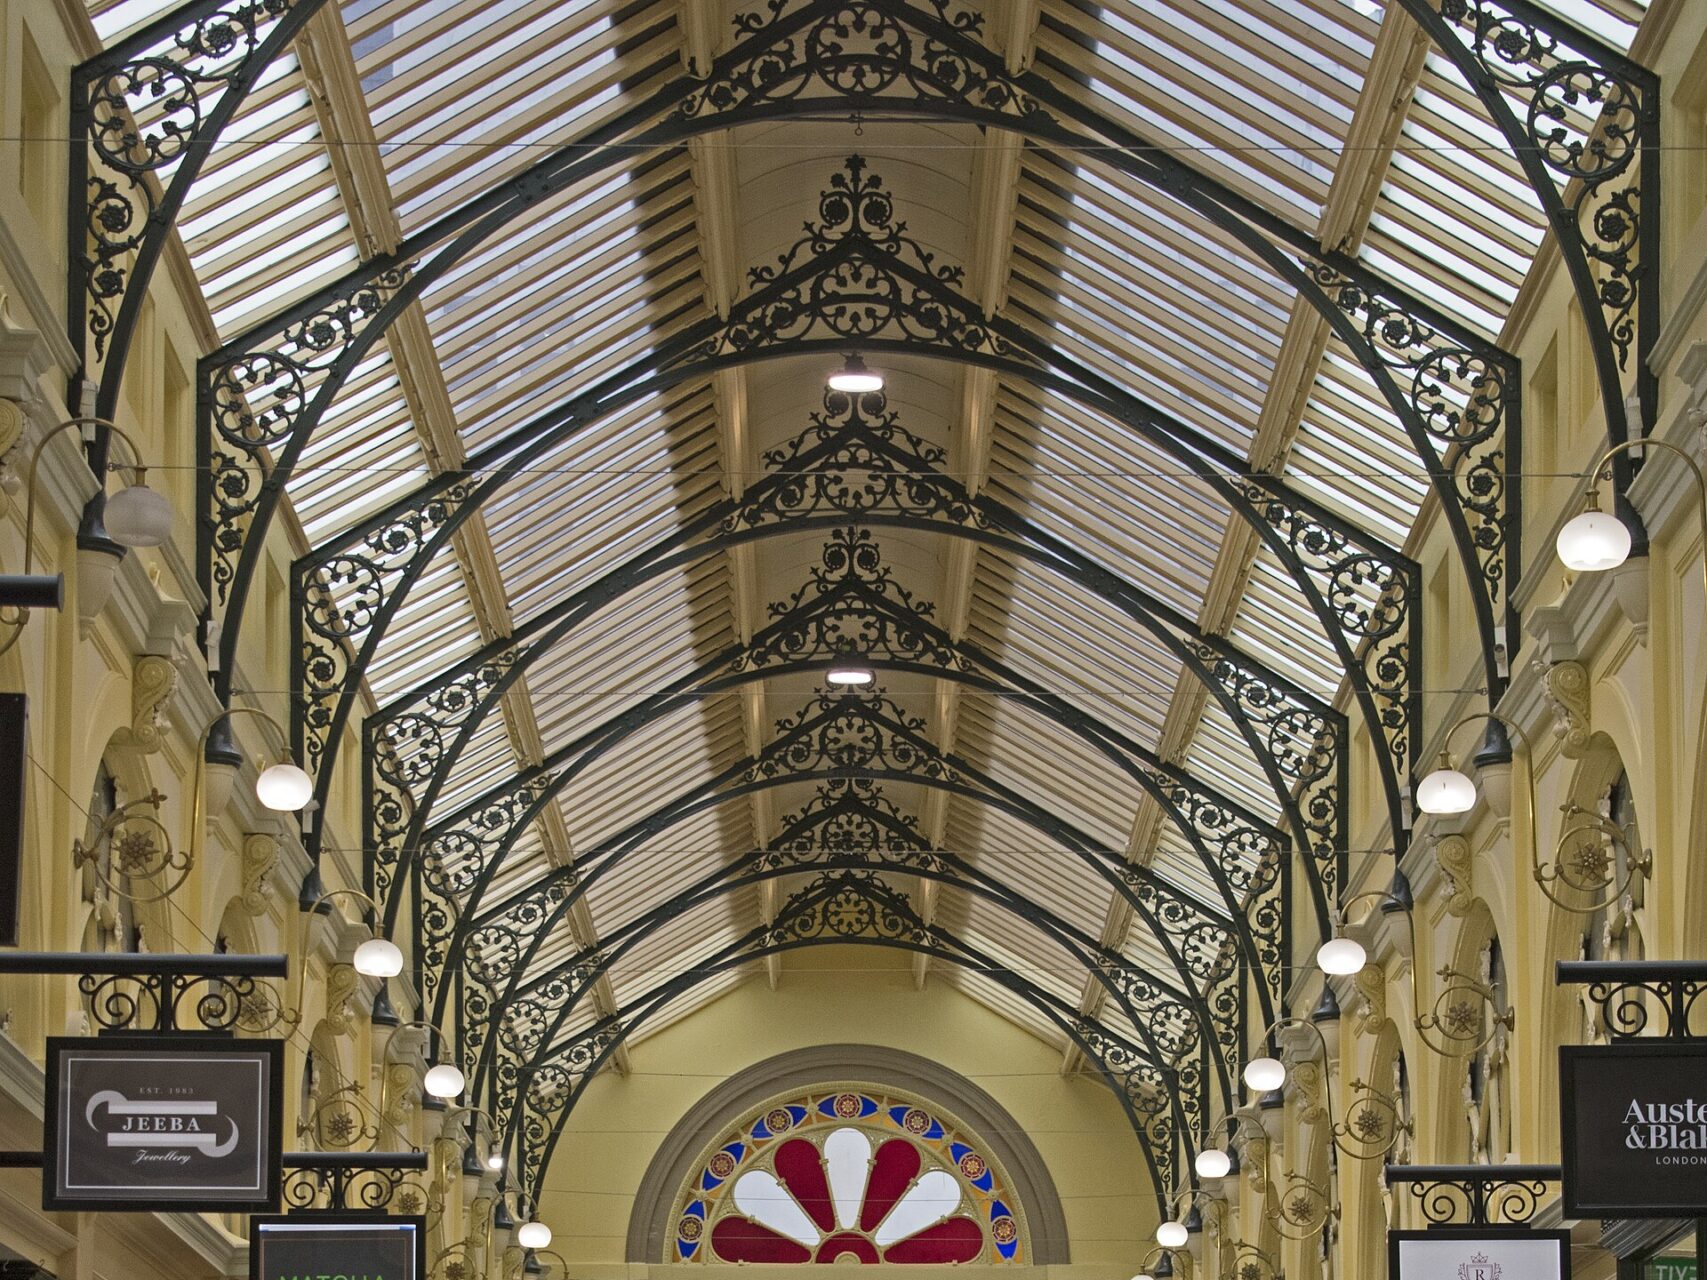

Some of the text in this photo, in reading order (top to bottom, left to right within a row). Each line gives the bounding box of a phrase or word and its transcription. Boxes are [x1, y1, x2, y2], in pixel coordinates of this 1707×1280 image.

[122, 1117, 201, 1131] JEEBA
[131, 1149, 192, 1165] Jewellery
[1656, 1156, 1707, 1165] LONDON
[1475, 1269, 1485, 1280] R
